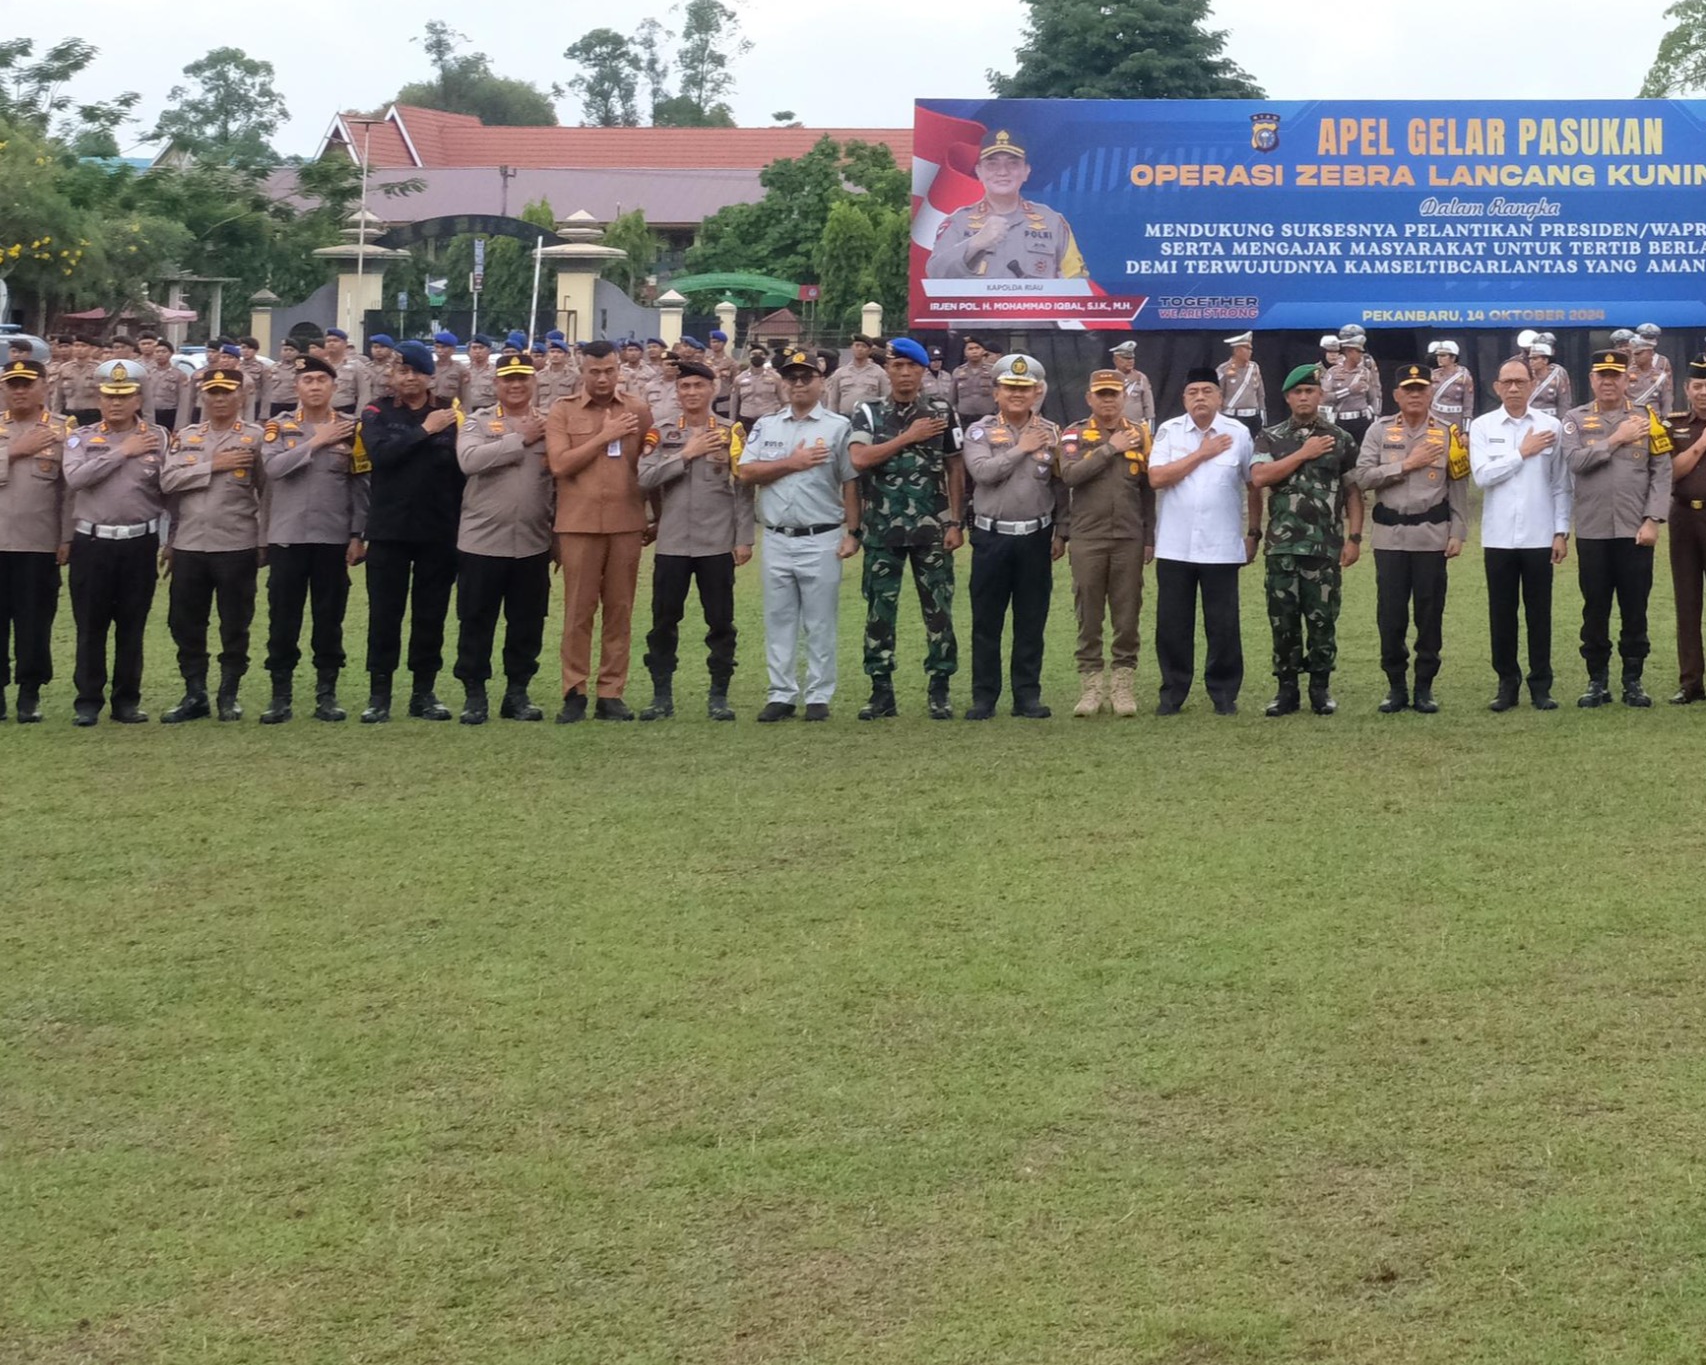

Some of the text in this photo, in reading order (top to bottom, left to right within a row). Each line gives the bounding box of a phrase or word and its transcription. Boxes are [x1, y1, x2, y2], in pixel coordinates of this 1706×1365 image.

[1317, 117, 1663, 156] APEL GELAR PASUKAN
[1130, 164, 1284, 187] OPERASI
[1295, 164, 1416, 187] ZEBRA
[1428, 164, 1596, 187] LANCANG
[1420, 197, 1561, 221] Dalam Rangka
[1144, 223, 1275, 238] MENDUKUNG
[1281, 223, 1398, 238] SUKSESNYA
[1404, 222, 1533, 238] PELANTIKAN
[1160, 241, 1225, 256] SERTA
[1231, 241, 1343, 256] MENGAJAK
[1349, 241, 1487, 256] MASYARAKAT
[1493, 241, 1563, 256] UNTUK
[1568, 241, 1642, 255] TERTIB
[1125, 260, 1178, 274] DEMI
[1183, 259, 1338, 274] TERWUJUDNYA
[1344, 259, 1578, 274] KAMSELTIBCARLANTAS
[1584, 259, 1637, 274] YANG
[1646, 258, 1706, 273] AMAN
[986, 283, 1044, 292] KAPOLDA RIAU
[929, 302, 957, 311] IRJEN
[993, 301, 1052, 311] MOHAMMAD
[1054, 301, 1086, 312] IQBAL,
[1158, 297, 1259, 308] TOGETHER
[1158, 307, 1259, 319] WE ARE STRONG
[1362, 308, 1605, 324] PEKANBARU, 14 OKTOBER 2024
